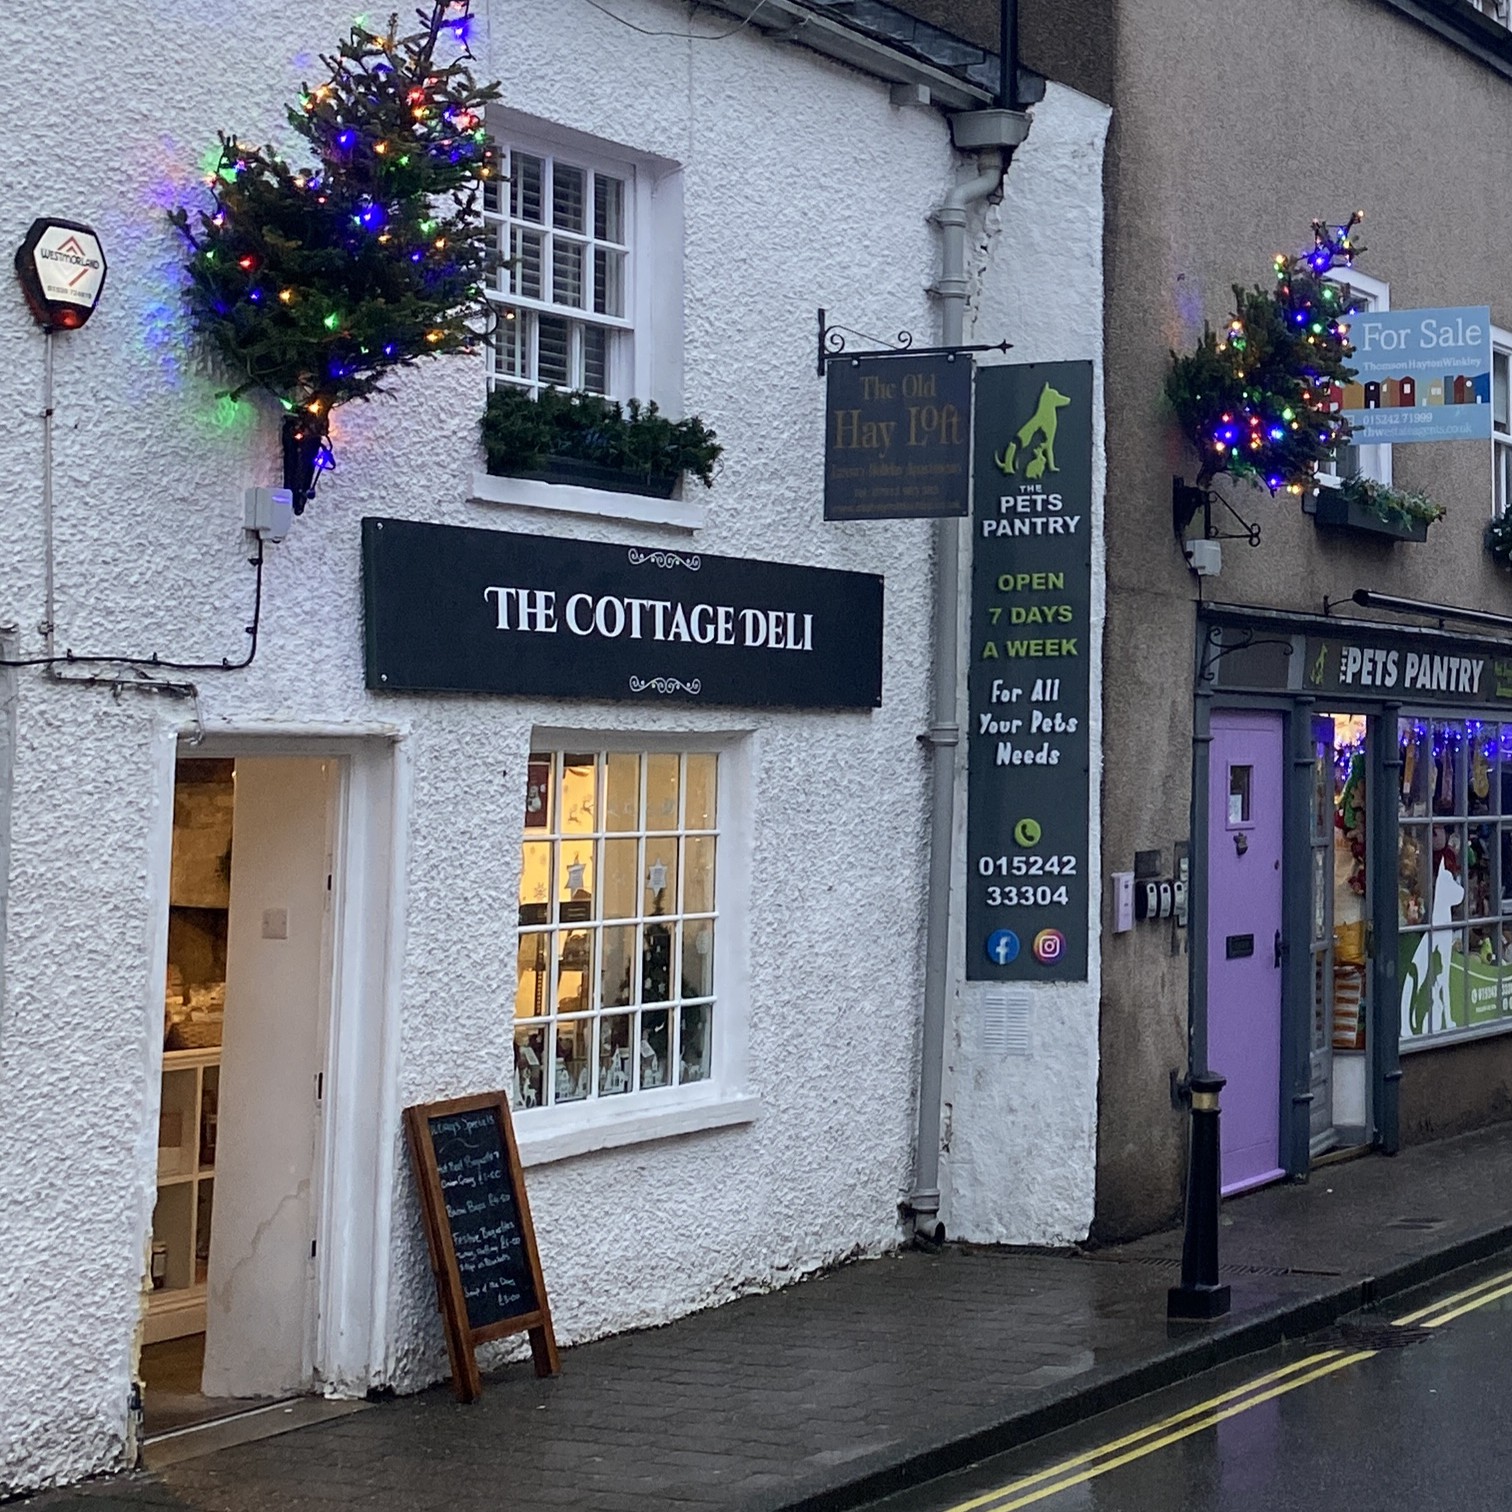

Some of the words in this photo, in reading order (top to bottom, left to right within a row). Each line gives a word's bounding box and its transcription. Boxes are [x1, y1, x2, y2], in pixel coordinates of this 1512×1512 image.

[41, 249, 99, 269] WESTMORLAND
[1363, 322, 1410, 351] For
[1420, 318, 1482, 348] Sale
[860, 375, 897, 400] The
[902, 373, 937, 398] Old
[833, 409, 897, 459] Hay
[907, 404, 963, 446] Loft
[1019, 485, 1042, 494] THE
[1000, 494, 1063, 513] PETS
[982, 515, 1081, 537] PANTRY
[998, 573, 1064, 591] OPEN
[483, 586, 558, 633] THE
[565, 593, 736, 645] COTTAGE
[738, 608, 814, 651] DELI
[989, 607, 1001, 624] 7
[1011, 605, 1073, 624] DAYS
[982, 641, 998, 659] A
[1007, 638, 1078, 658] WEEK
[1339, 646, 1349, 684] THE
[1346, 647, 1399, 688] PETS
[1404, 652, 1484, 694] PANTRY
[991, 679, 1022, 703] For
[1030, 678, 1060, 702] All
[980, 713, 1022, 735] Your
[1030, 710, 1078, 734] Pets
[995, 742, 1060, 765] Needs
[978, 855, 1077, 876] 015242
[986, 886, 1069, 906] 33304
